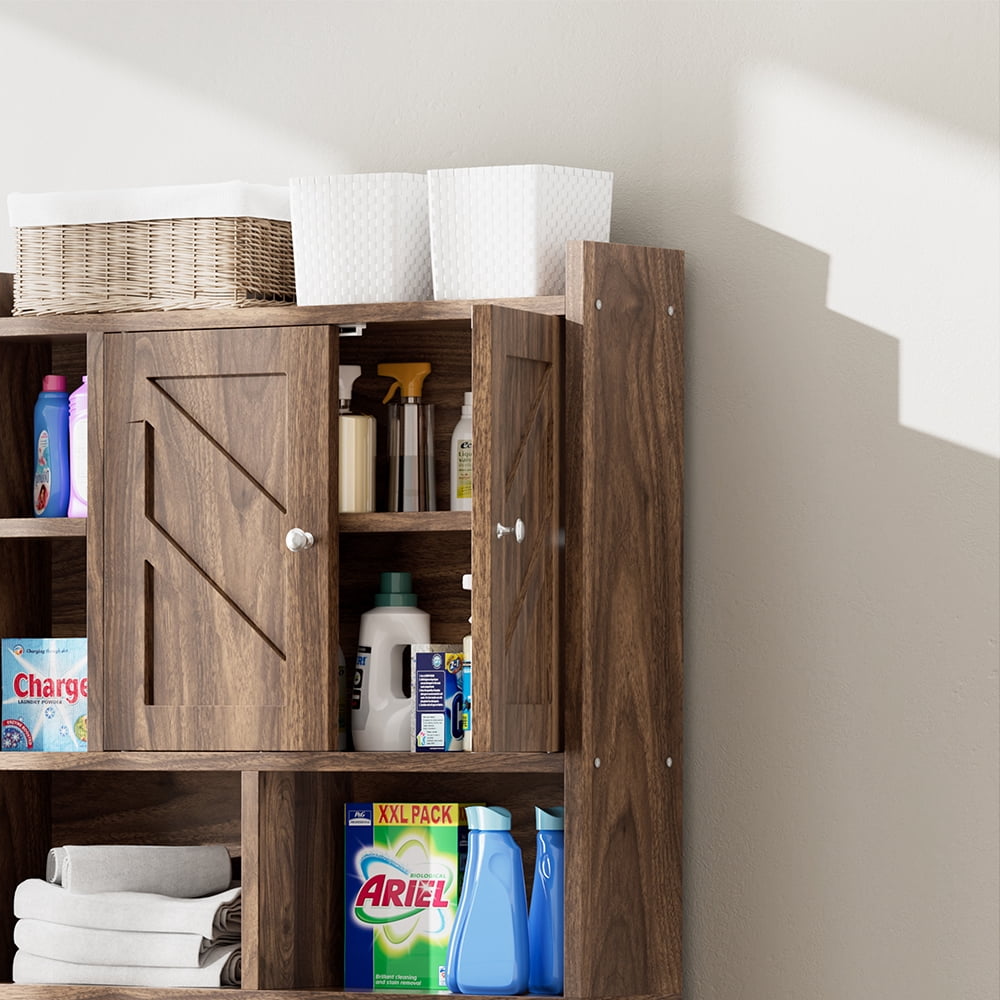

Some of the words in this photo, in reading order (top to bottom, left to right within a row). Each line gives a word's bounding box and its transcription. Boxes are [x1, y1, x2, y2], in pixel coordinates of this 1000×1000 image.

[13, 673, 88, 704] Charge
[378, 804, 408, 824] XXL
[411, 804, 453, 825] PACK
[355, 874, 449, 908] ARIEL
